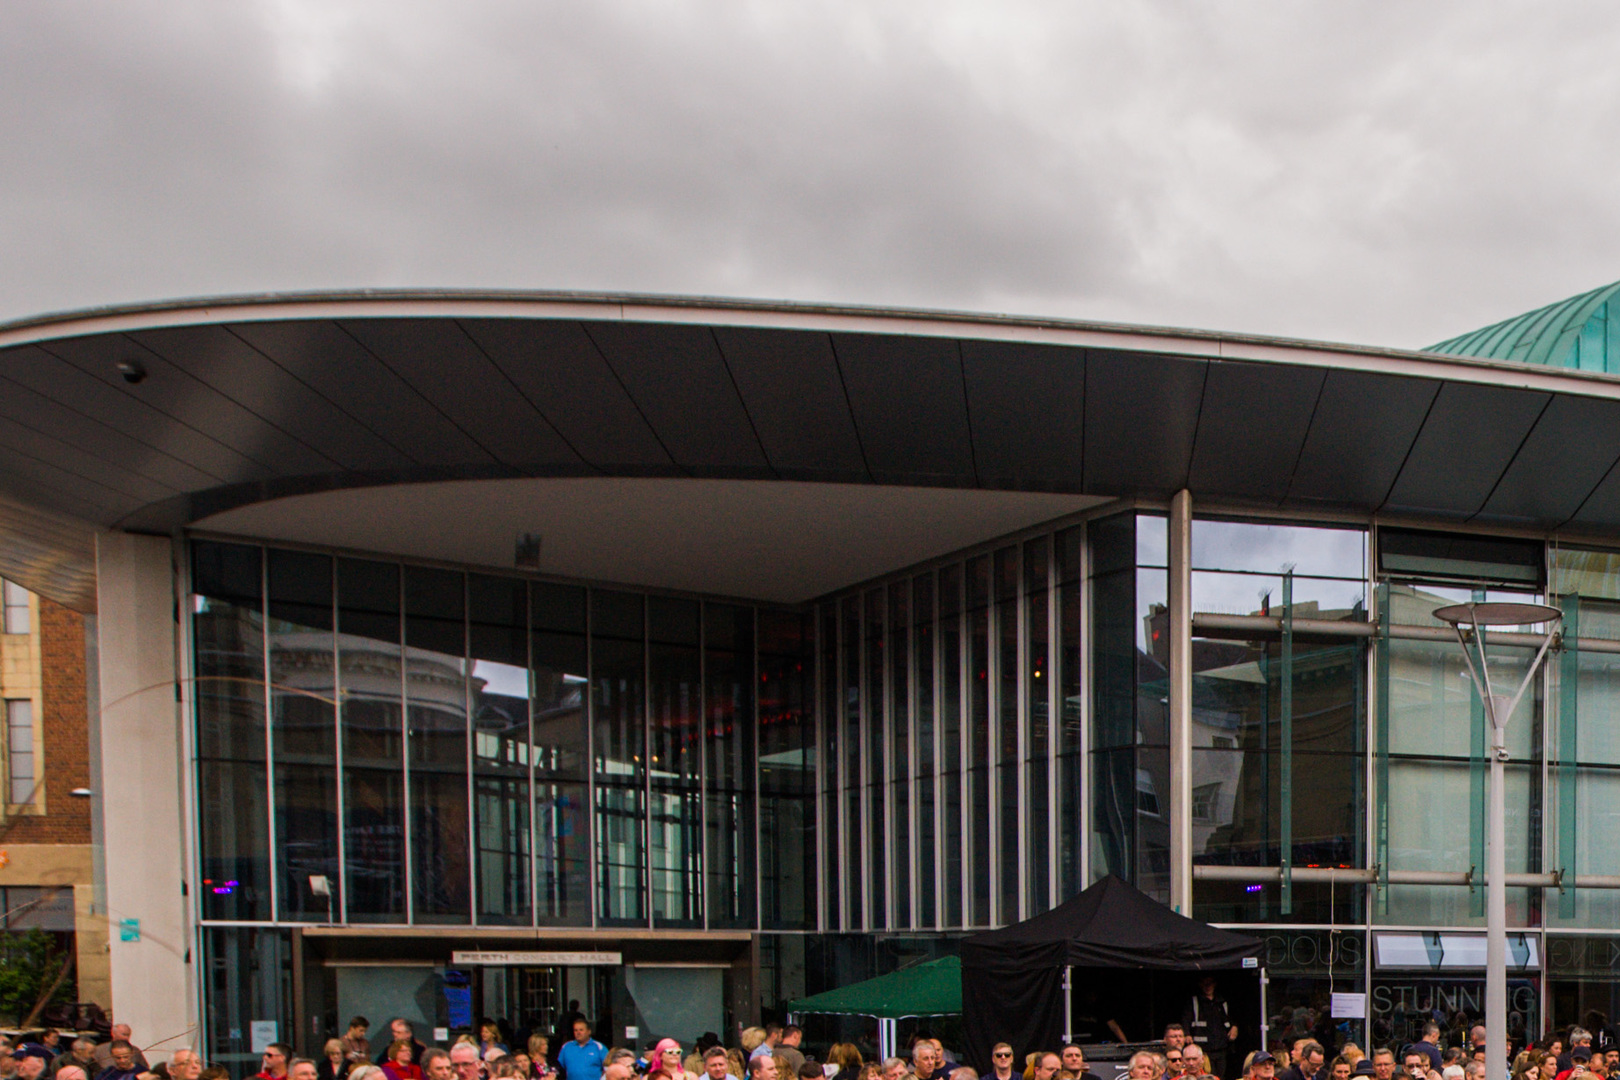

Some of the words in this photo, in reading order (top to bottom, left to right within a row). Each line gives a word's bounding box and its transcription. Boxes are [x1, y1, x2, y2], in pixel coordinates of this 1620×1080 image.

[461, 953, 509, 961] PERTH
[513, 953, 575, 961] CONCERT
[579, 954, 614, 962] HALL
[1264, 935, 1361, 965] CIOUS
[1372, 985, 1535, 1013] STUNNG
[1372, 1018, 1459, 1041] QUIY
